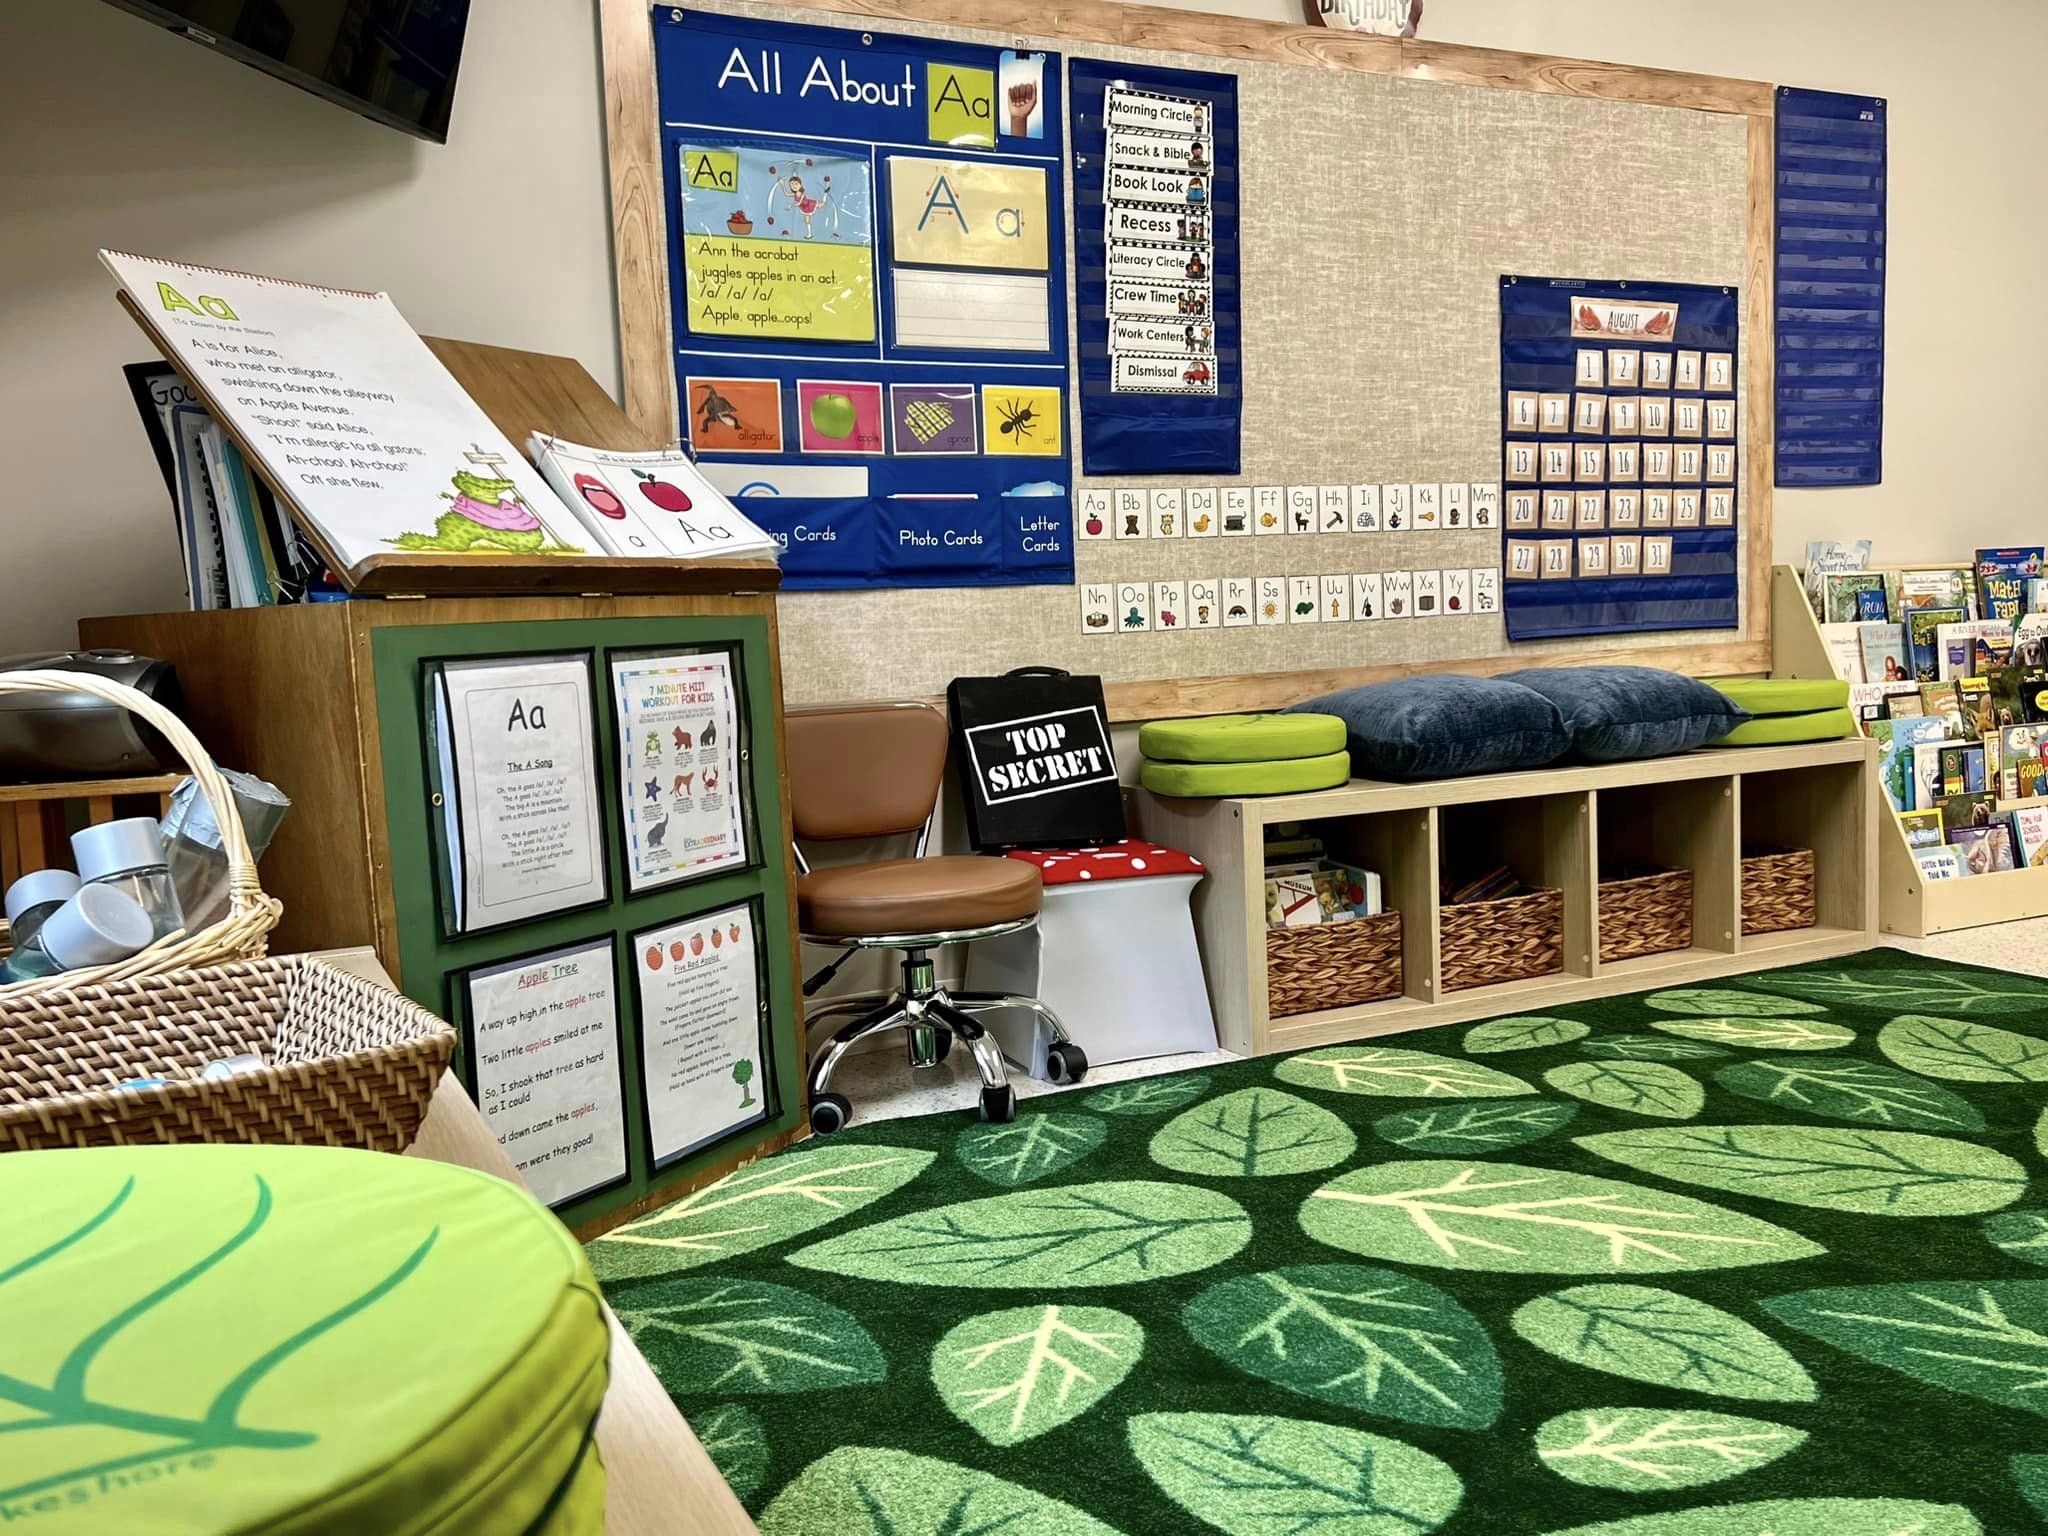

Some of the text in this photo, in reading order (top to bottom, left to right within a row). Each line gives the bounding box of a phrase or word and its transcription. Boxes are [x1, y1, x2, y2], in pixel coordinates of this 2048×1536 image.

[717, 47, 917, 109] All About
[934, 74, 991, 119] Aa
[1112, 100, 1193, 122] Morning Circle
[1114, 142, 1191, 160] Snack & Bible
[692, 153, 734, 189] Aa
[1114, 174, 1184, 194] Book Look
[1120, 214, 1171, 233] Recess
[698, 241, 799, 262] Ann the acrobat
[1113, 253, 1185, 268] Literacy Circle
[700, 264, 838, 287] juggles apples in an act.
[156, 281, 241, 322] Aa
[699, 285, 774, 303] /a/ /a/ /a/
[1114, 287, 1177, 304] Crew Time
[701, 305, 742, 326] Apple,
[1607, 310, 1640, 330] AUGUST
[1117, 327, 1184, 342] Work Centers
[206, 341, 219, 351] is
[220, 342, 240, 354] for
[206, 358, 237, 371] who
[240, 361, 265, 373] met
[268, 366, 286, 375] an
[1127, 365, 1177, 378] Dismissal
[1586, 356, 1722, 383] 1 2 3 4 5
[221, 376, 395, 403] swishing down the alleyway
[237, 396, 257, 407] on
[260, 397, 299, 411] Apple
[1521, 401, 1727, 430] 6 7 8 9 10 11 12
[306, 420, 335, 432] said
[737, 430, 777, 445] alligator
[856, 431, 880, 445] apple
[946, 433, 972, 446] apron
[1043, 433, 1057, 445] ant
[1085, 494, 1106, 511] Aa
[1122, 493, 1141, 511] Bb
[1192, 492, 1212, 509] Dd
[1227, 492, 1245, 508] Ee
[1260, 491, 1277, 507] Ff
[1293, 491, 1313, 515] Gg
[1326, 491, 1343, 506] Hh
[1390, 488, 1403, 512] Jj
[1419, 488, 1433, 504] Kk
[1473, 487, 1496, 502] Mm
[678, 517, 734, 545] Aa
[1020, 516, 1061, 532] Letter
[794, 525, 837, 543] Cards
[899, 530, 984, 547] Photo Cards
[1021, 537, 1061, 552] Cards
[1088, 573, 1493, 608] Nn Oo Pp Qq Rr Ss Tt Uu Vv Ww Xx Yy Zz
[656, 682, 688, 695] MINUTE
[1853, 687, 1882, 702] WHO
[641, 691, 716, 709] WORKOUT FOR KIDS
[508, 698, 547, 732] Aa
[1005, 722, 1067, 757] TOP
[507, 758, 553, 772] The A Song
[988, 746, 1102, 793] SECRET
[1283, 879, 1313, 892] MUSEUM
[517, 961, 579, 989] Apple Tree
[480, 1022, 487, 1033] A
[488, 1018, 505, 1031] way
[506, 1014, 517, 1027] up
[519, 1008, 538, 1022] high
[549, 1000, 564, 1013] the
[564, 994, 586, 1009] apple
[588, 989, 606, 1002] tree
[481, 1021, 603, 1065] Two little apples smiled at me
[485, 1051, 605, 1100] So, I shook that tree as hard
